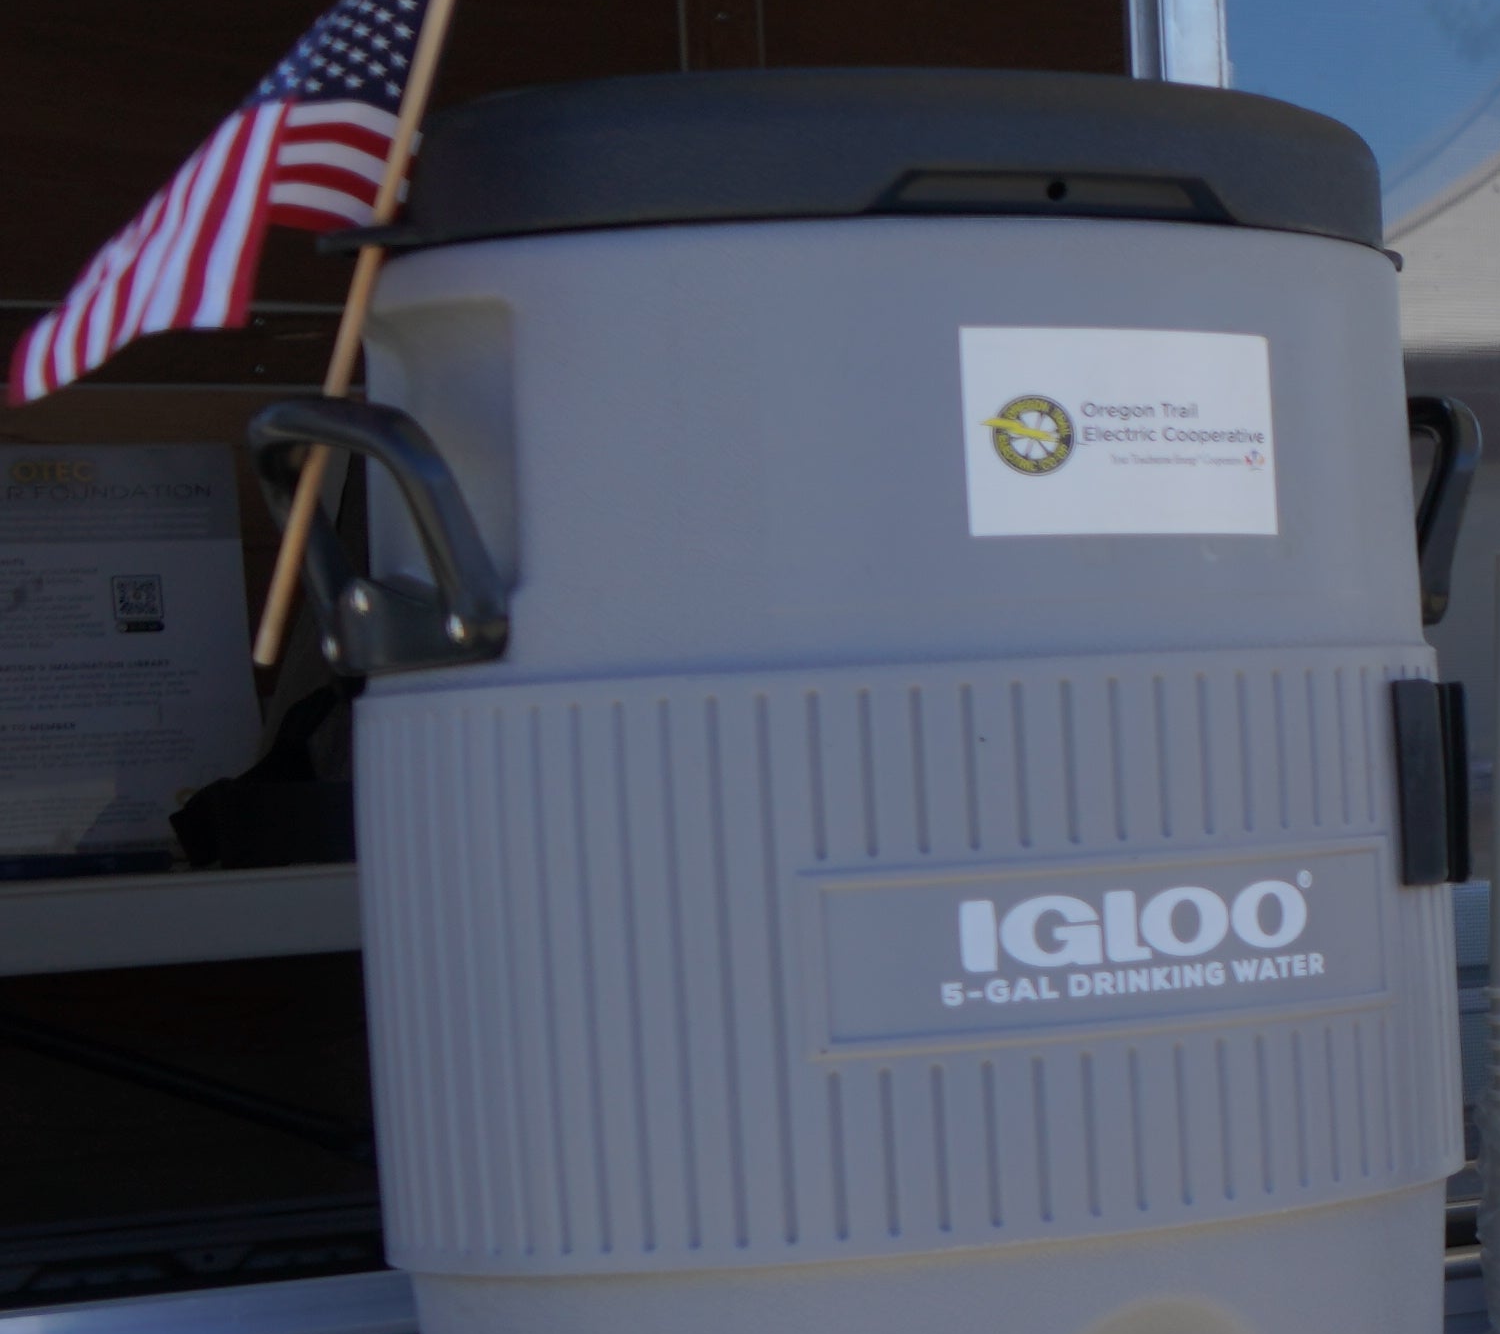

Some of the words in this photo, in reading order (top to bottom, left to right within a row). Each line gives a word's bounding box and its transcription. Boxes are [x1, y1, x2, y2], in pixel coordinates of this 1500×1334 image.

[1079, 402, 1156, 421] Oregon
[1159, 403, 1198, 418] Trail
[1083, 426, 1157, 442] Electric
[1162, 426, 1264, 444] Cooperative
[12, 459, 96, 484] OTEC
[33, 483, 212, 500] FOUNDATION
[959, 879, 1308, 974] IGLOO
[940, 976, 1060, 1007] 5-GAL
[1067, 963, 1226, 997] DRINKING
[1231, 953, 1325, 984] WATER
